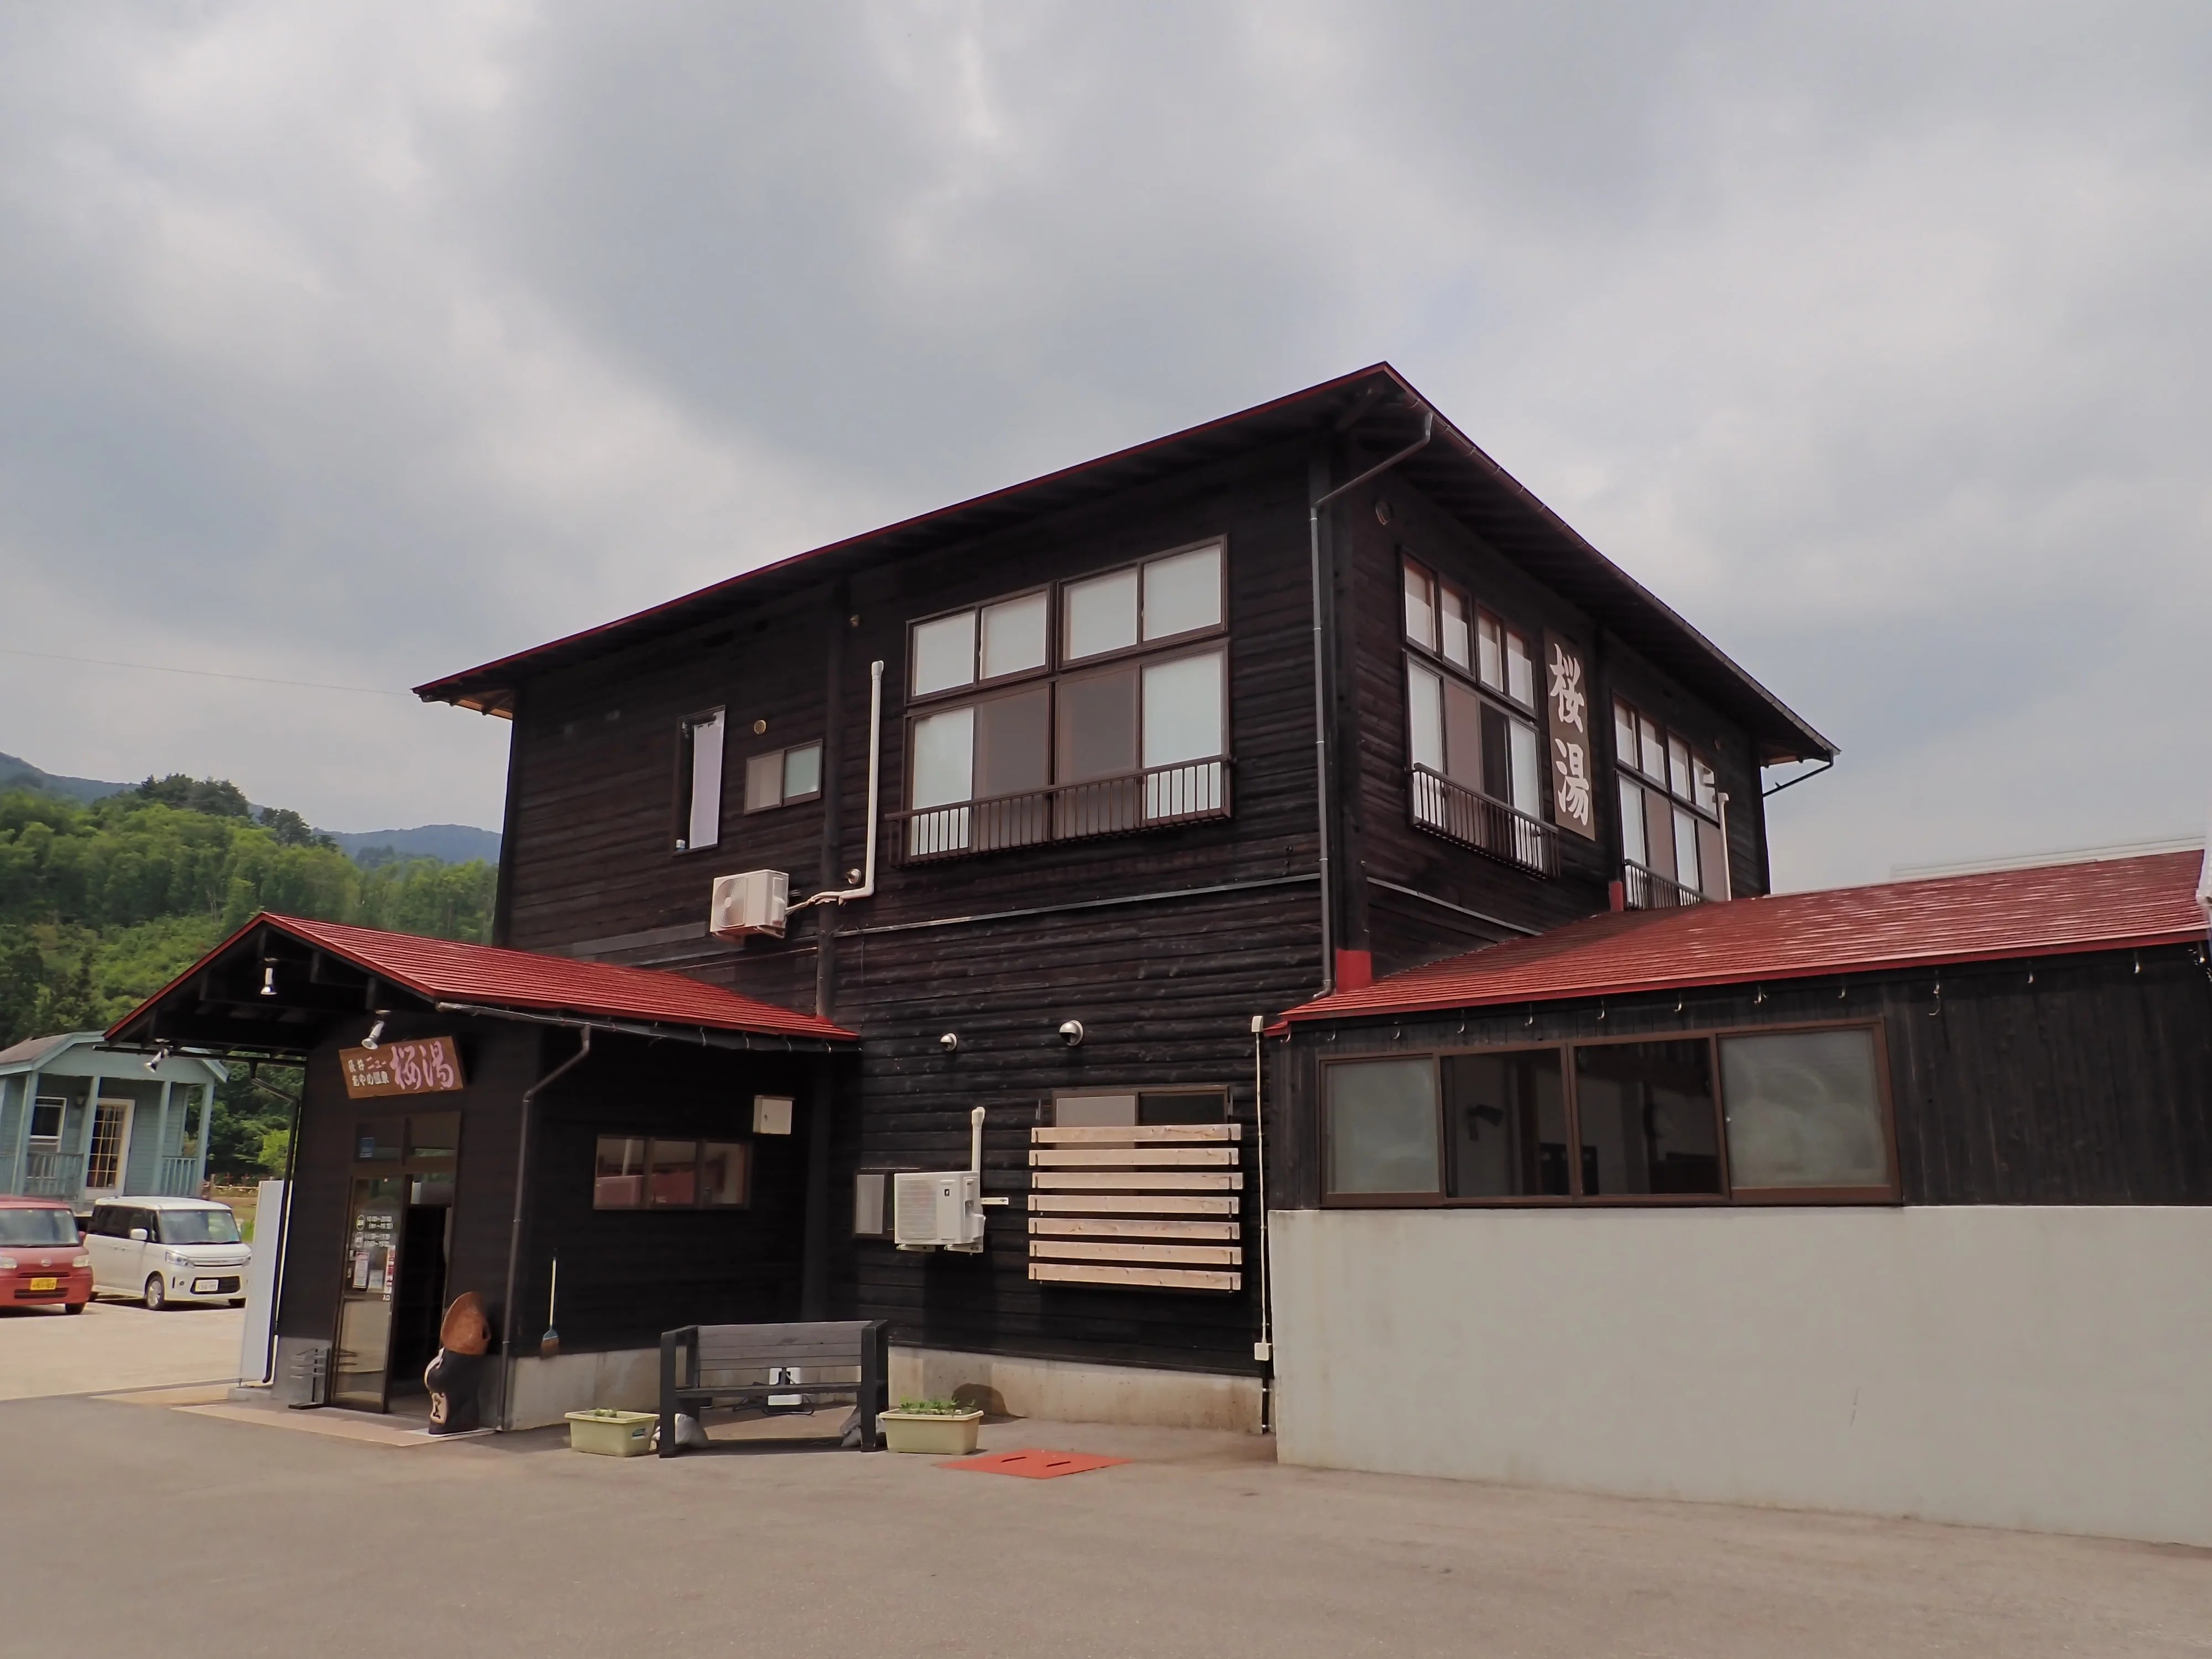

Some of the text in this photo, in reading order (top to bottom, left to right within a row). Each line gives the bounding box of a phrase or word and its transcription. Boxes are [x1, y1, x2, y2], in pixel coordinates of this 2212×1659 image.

[1549, 643, 1589, 825] 桜湯
[352, 1071, 389, 1087] あやめ温泉
[389, 1041, 454, 1091] 桜湯
